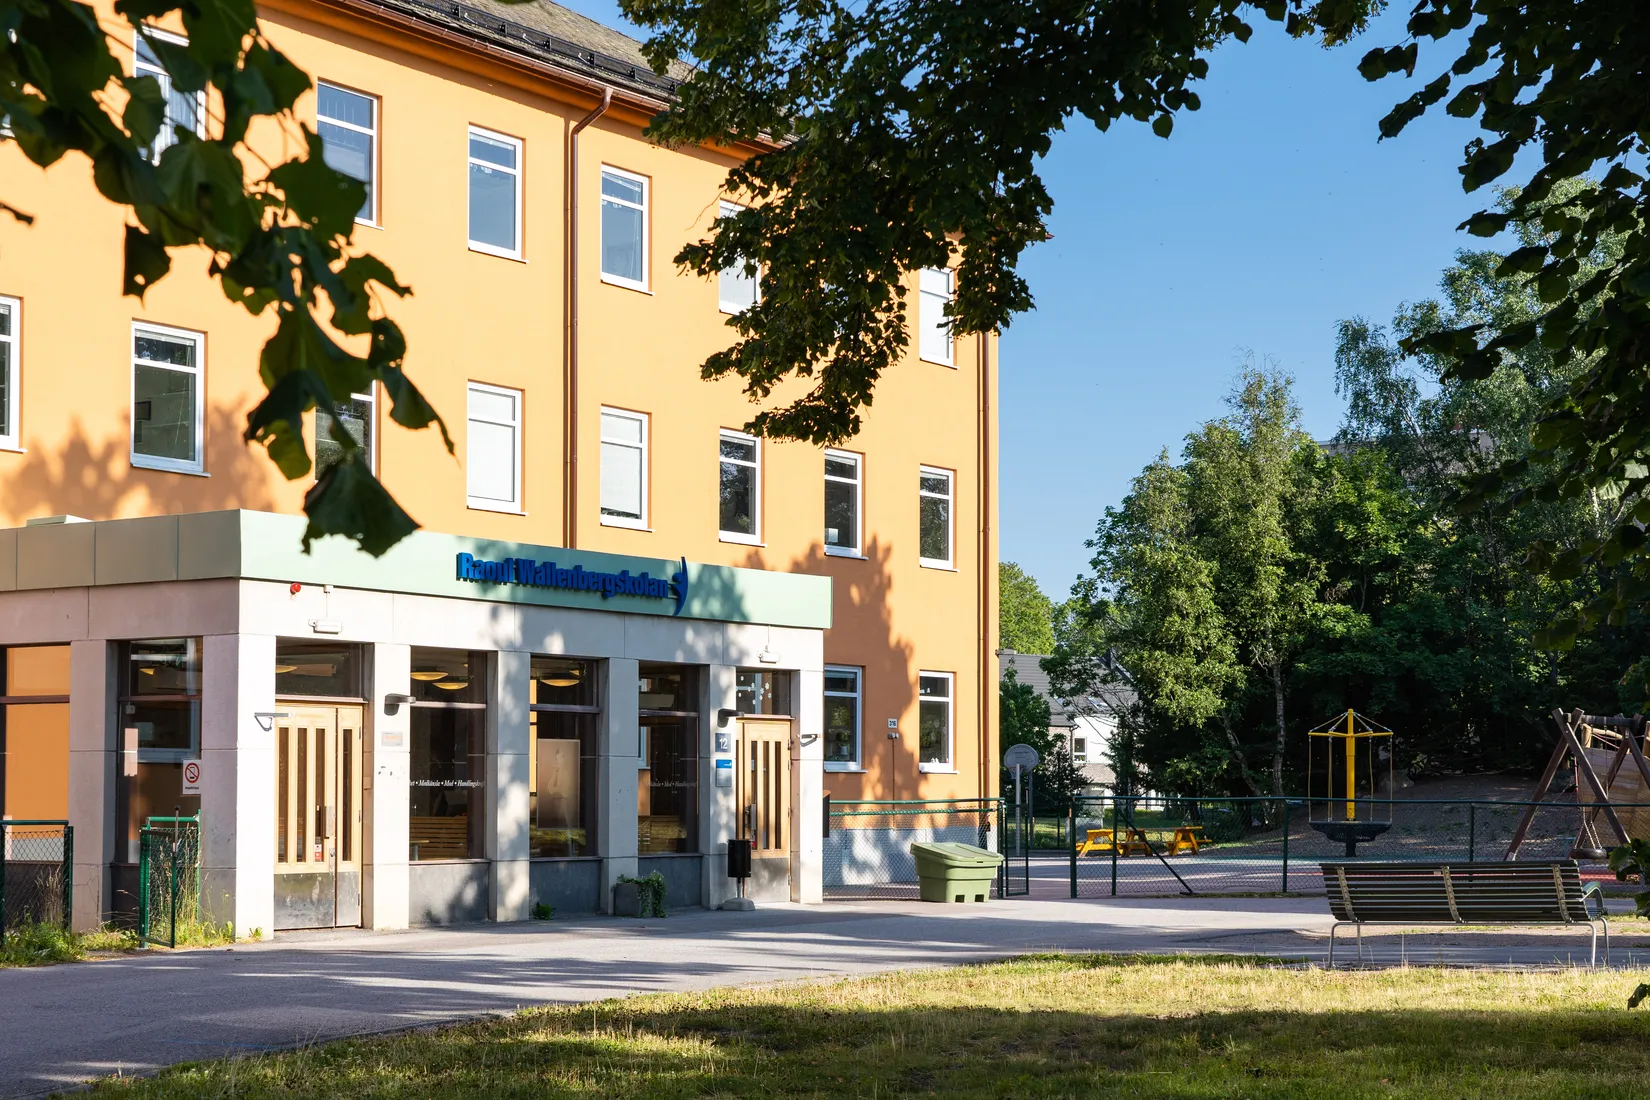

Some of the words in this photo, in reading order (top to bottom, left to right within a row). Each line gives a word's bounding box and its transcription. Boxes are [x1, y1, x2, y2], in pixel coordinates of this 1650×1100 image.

[456, 552, 514, 583] Raoul
[515, 558, 669, 598] Wallenbergskolan
[719, 737, 728, 750] 12
